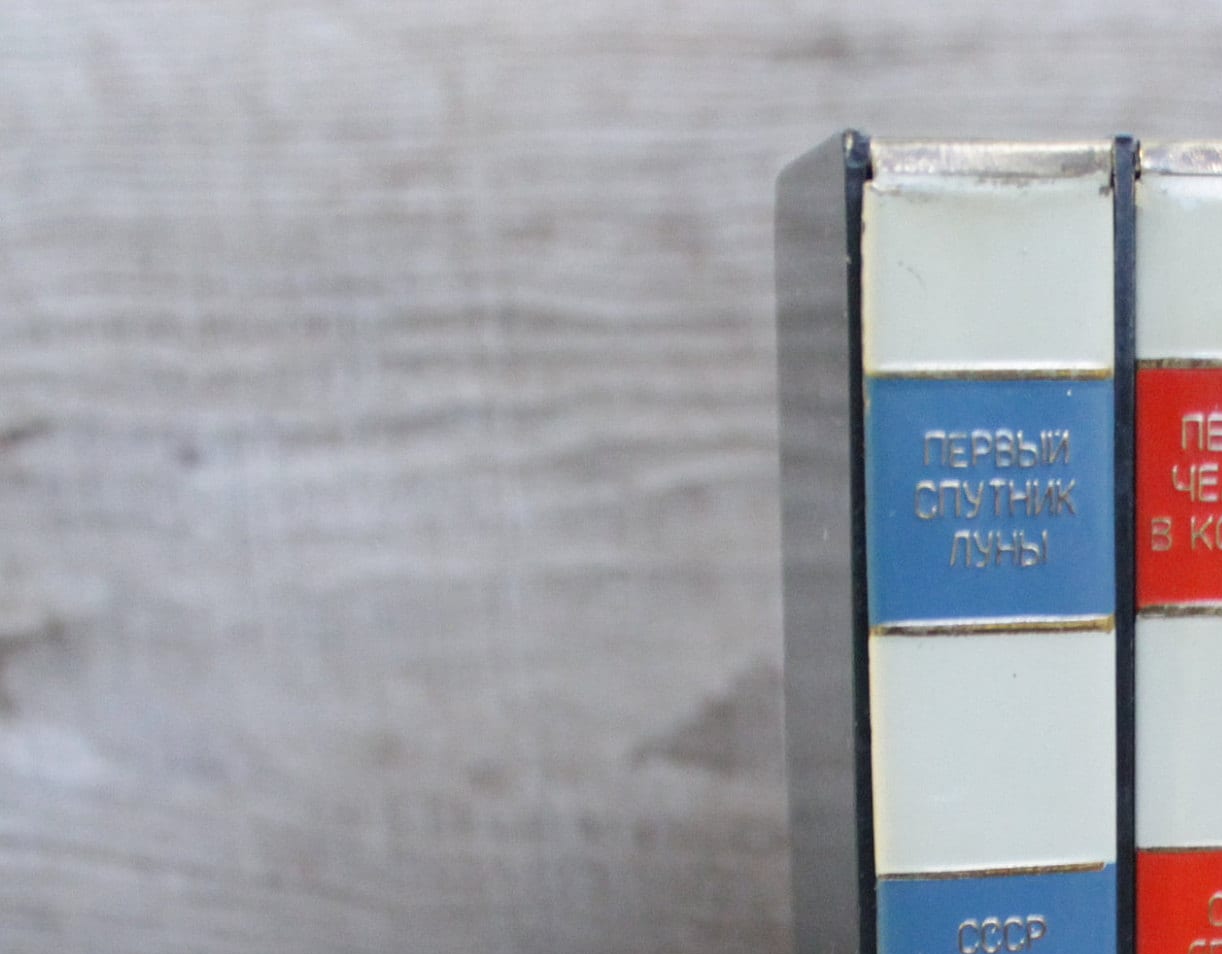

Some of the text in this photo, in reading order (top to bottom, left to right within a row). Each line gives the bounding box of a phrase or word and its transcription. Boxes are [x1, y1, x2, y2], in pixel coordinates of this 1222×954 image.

[923, 428, 1071, 468] ПЕРВЫЙ
[914, 478, 1076, 520] СПУТНИК
[951, 529, 1048, 568] ЛУНЫ
[1151, 516, 1172, 551] В
